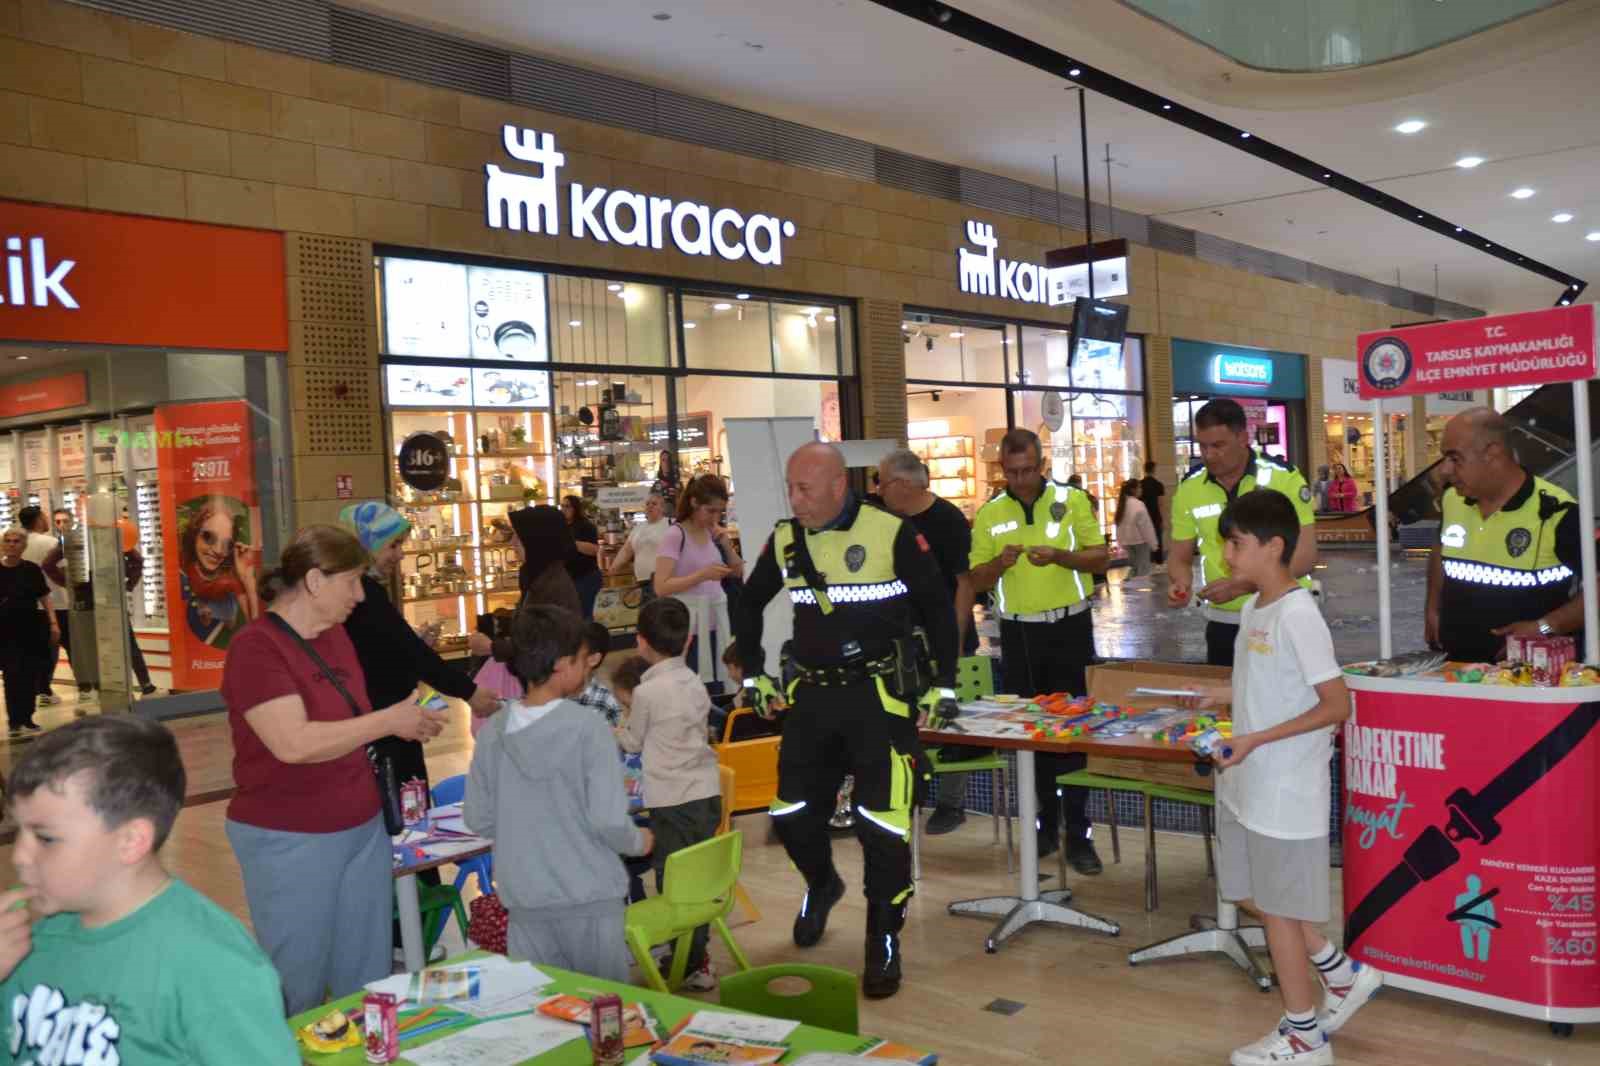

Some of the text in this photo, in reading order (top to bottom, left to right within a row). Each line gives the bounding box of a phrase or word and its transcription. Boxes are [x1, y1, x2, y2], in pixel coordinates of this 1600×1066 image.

[570, 182, 783, 266] karaca
[0, 237, 81, 308] ik
[1425, 334, 1575, 363] TARSUS KAYMAKAMLIĞI
[1416, 350, 1588, 384] İLÇE EMNİYET MÜDÜRLÜĞÜ
[1547, 894, 1595, 912] %45
[1546, 936, 1597, 956] %60
